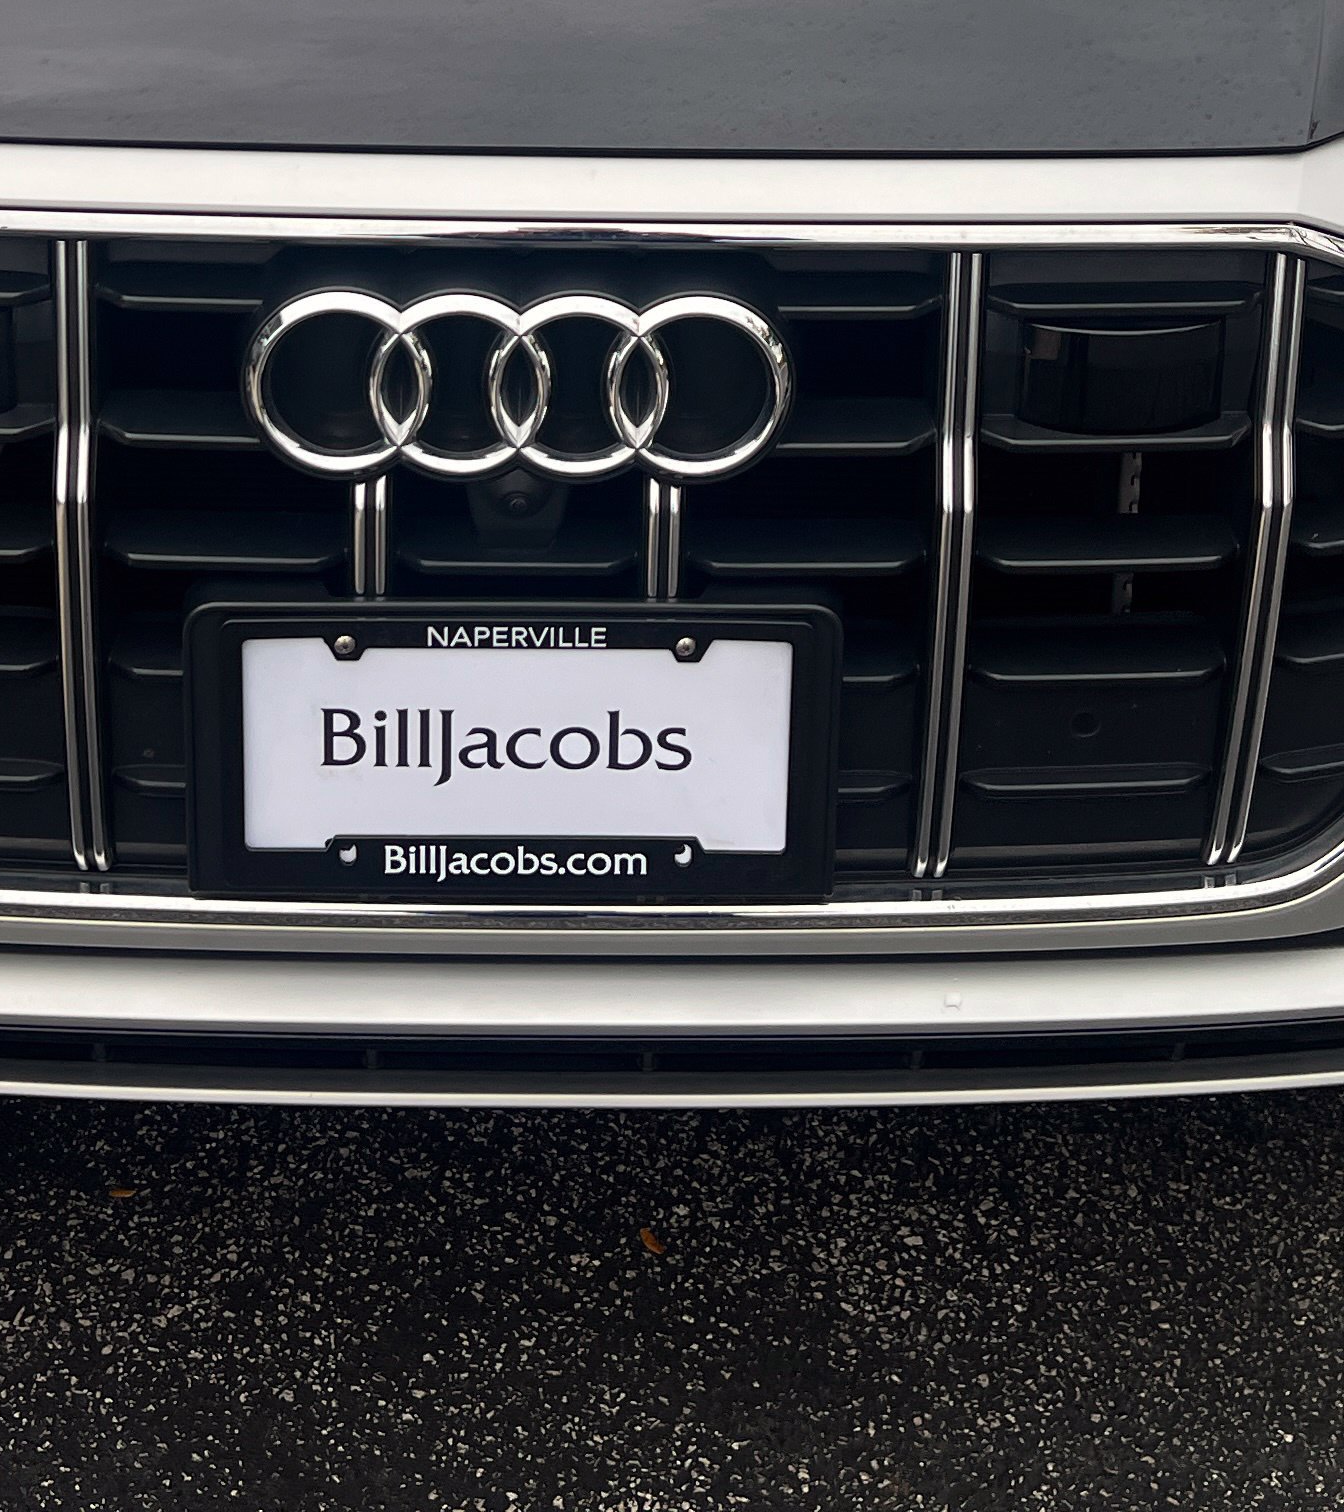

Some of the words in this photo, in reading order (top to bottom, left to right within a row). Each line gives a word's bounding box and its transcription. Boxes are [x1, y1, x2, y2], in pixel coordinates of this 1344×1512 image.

[427, 626, 607, 648] NAPERVILLE
[320, 707, 692, 787] BillJacobs
[383, 844, 648, 882] BillJacobs.com
